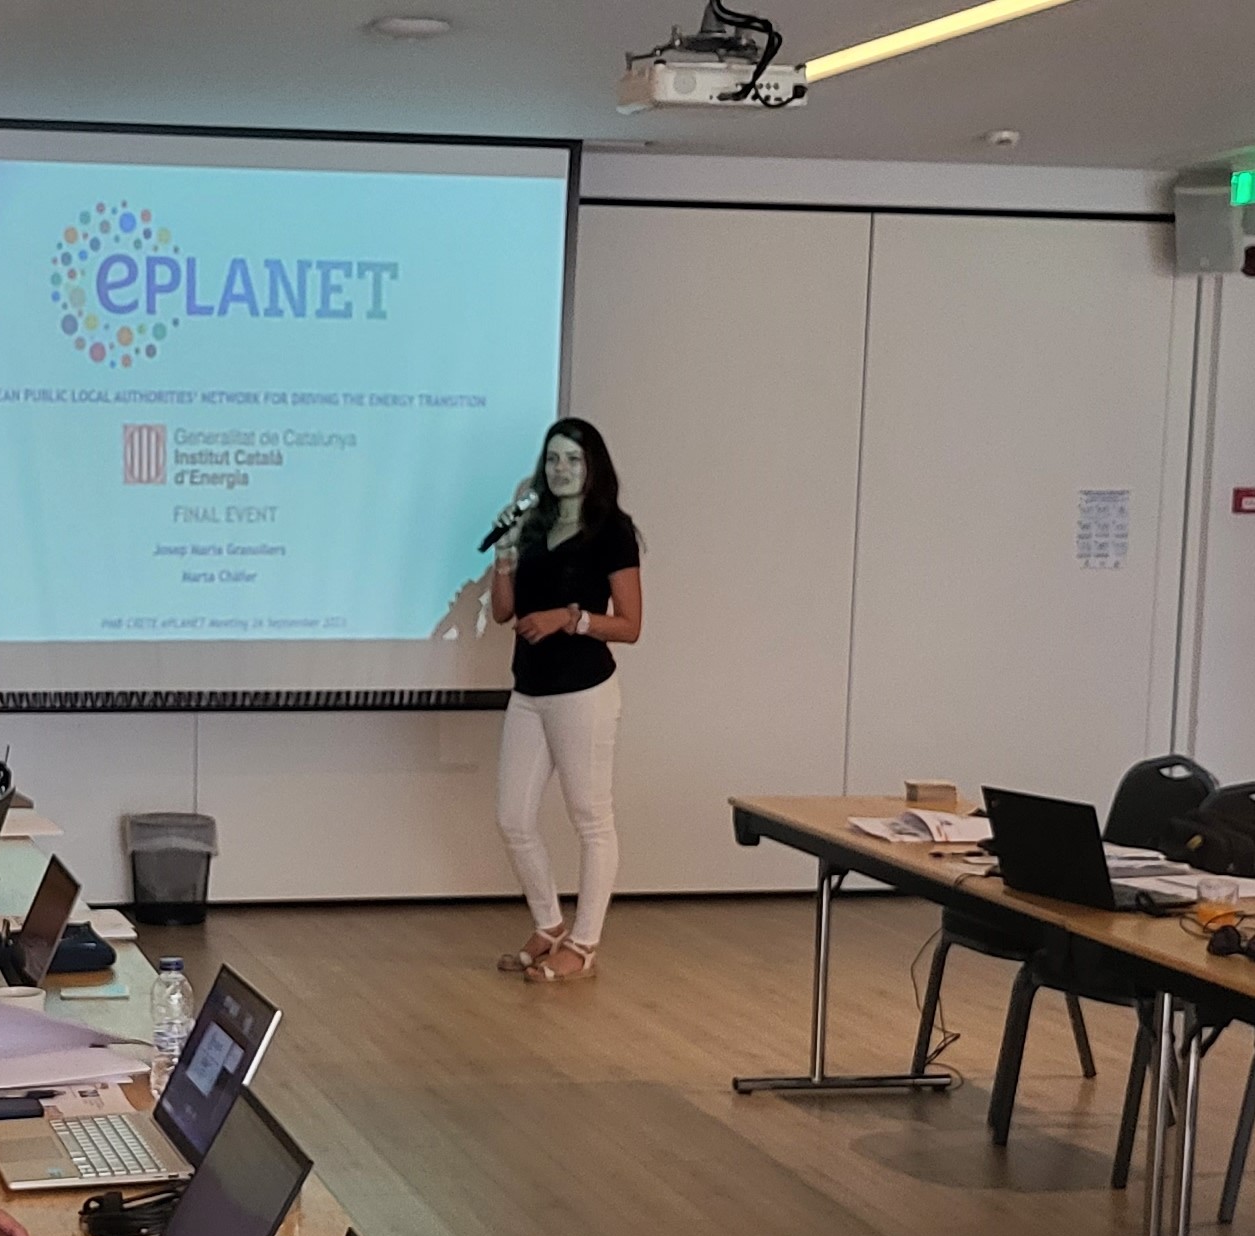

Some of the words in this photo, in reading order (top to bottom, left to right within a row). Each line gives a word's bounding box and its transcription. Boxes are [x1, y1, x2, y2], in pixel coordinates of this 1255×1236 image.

[96, 253, 399, 320] ePLANET
[24, 388, 66, 402] PUBLIC
[71, 388, 109, 403] LOCAL
[202, 390, 260, 405] NETWORK
[264, 391, 287, 405] FOR
[342, 391, 365, 406] THE
[369, 392, 415, 406] ENERGY
[419, 392, 487, 408] TRANSITION
[174, 428, 255, 447] Generalitat
[259, 429, 279, 447] de
[283, 429, 357, 450] Catalunya
[174, 449, 230, 466] Institut
[234, 449, 284, 466] Català
[174, 470, 249, 489] d'Energia
[174, 507, 220, 523] FINAL
[226, 506, 278, 523] EVENT
